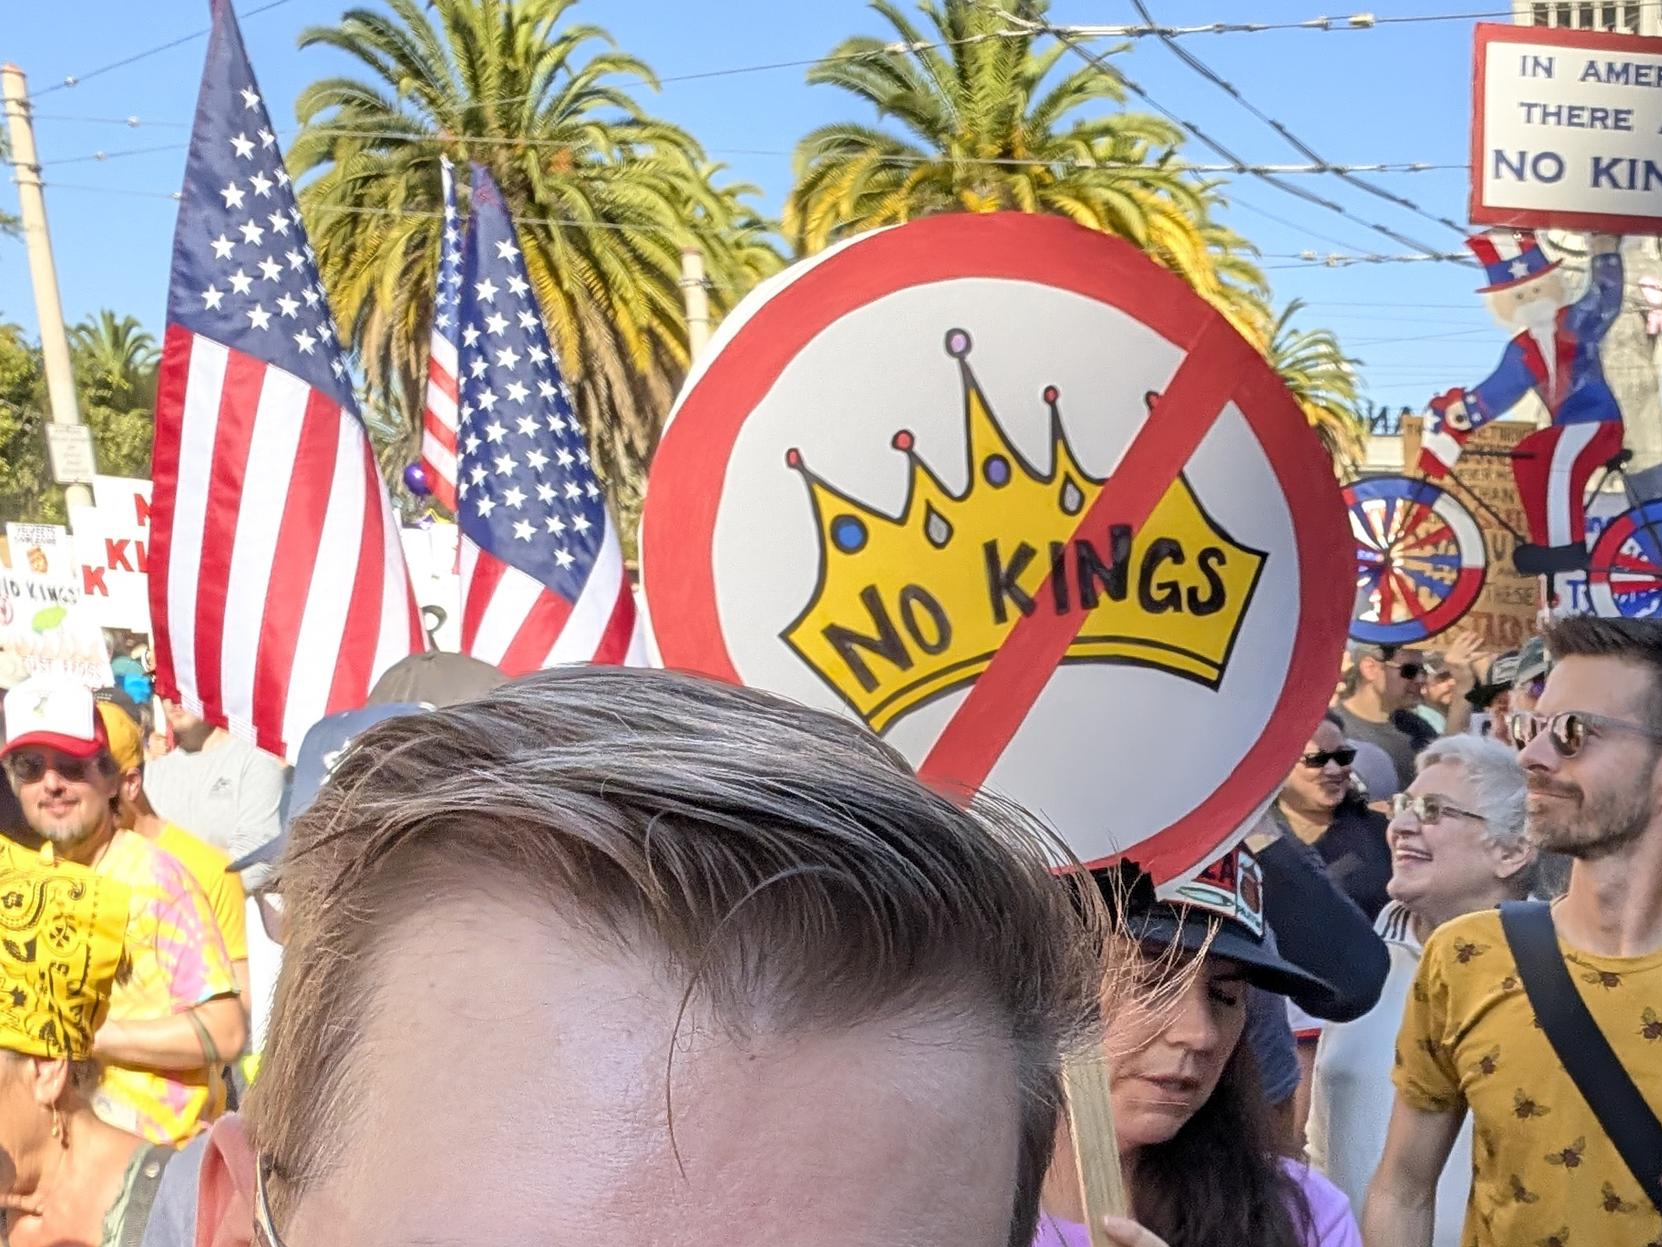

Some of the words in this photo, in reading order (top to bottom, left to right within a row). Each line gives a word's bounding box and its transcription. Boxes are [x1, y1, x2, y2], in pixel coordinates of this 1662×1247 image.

[1520, 55, 1554, 79] IN
[1520, 102, 1632, 131] THERE
[1492, 149, 1564, 183] NO
[821, 583, 951, 694] NO
[983, 525, 1227, 625] KINGS
